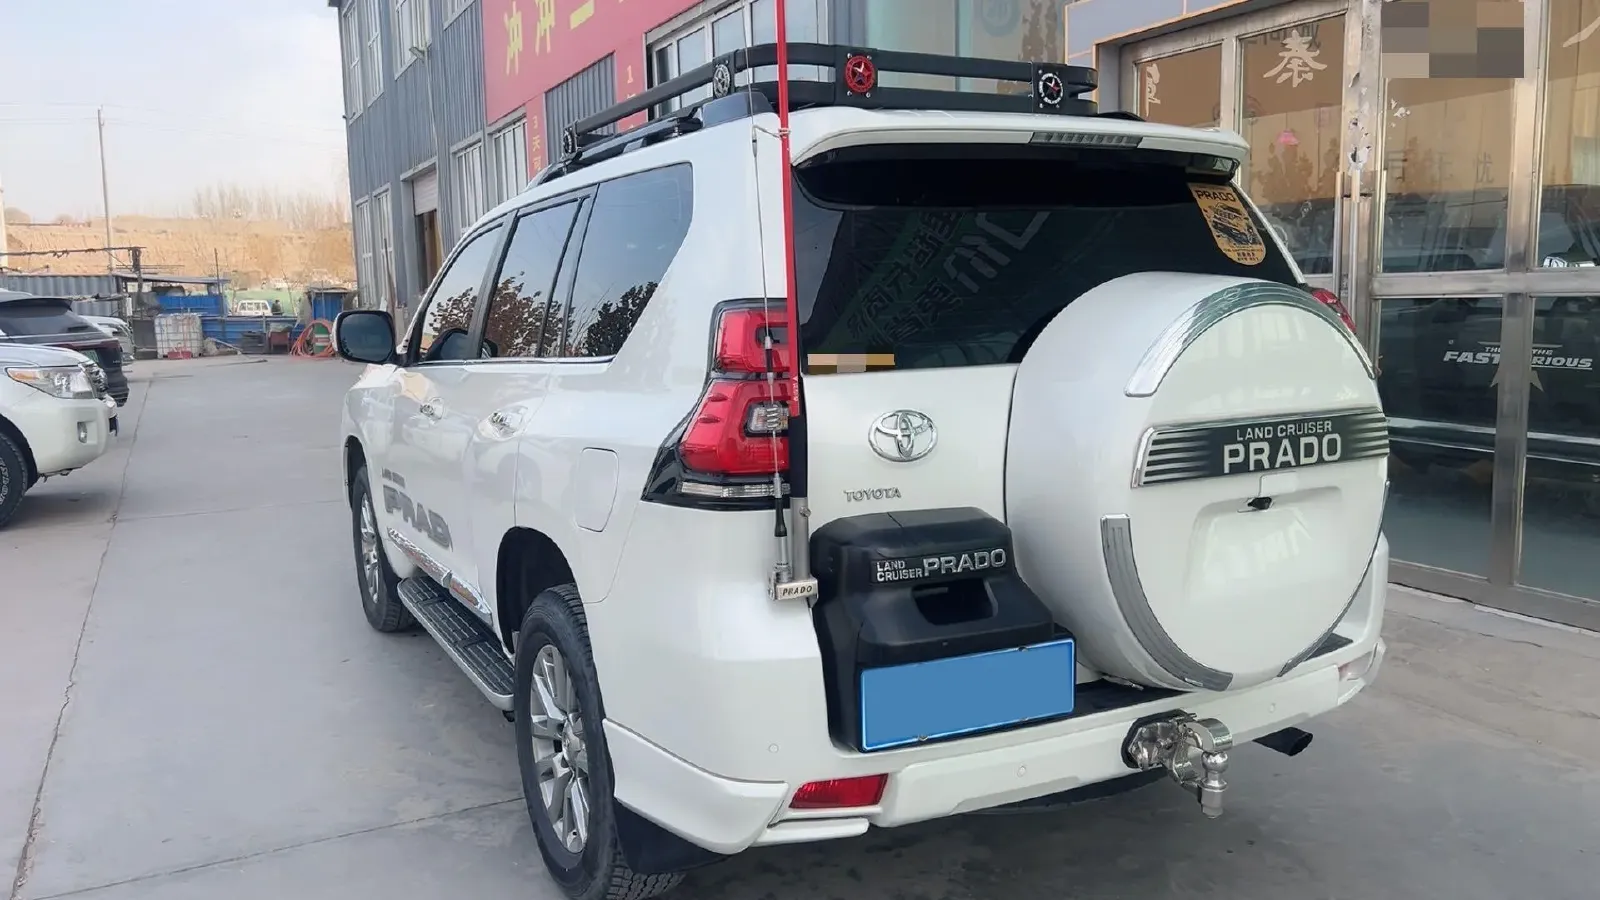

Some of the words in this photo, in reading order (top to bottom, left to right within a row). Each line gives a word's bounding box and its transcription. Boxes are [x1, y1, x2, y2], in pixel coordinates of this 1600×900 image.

[503, 0, 594, 76] 冲冲
[1194, 189, 1236, 202] PRADO
[1443, 351, 1500, 364] FAST
[1532, 356, 1593, 368] RIOUS
[1236, 425, 1273, 441] LAND
[1277, 420, 1332, 437] CRUISER
[1223, 433, 1341, 474] PRADO
[843, 487, 902, 502] TOYOTA
[876, 560, 905, 571] LAND
[923, 548, 1007, 577] PRADO
[876, 568, 923, 582] CRUISER
[782, 585, 813, 596] PRADO
